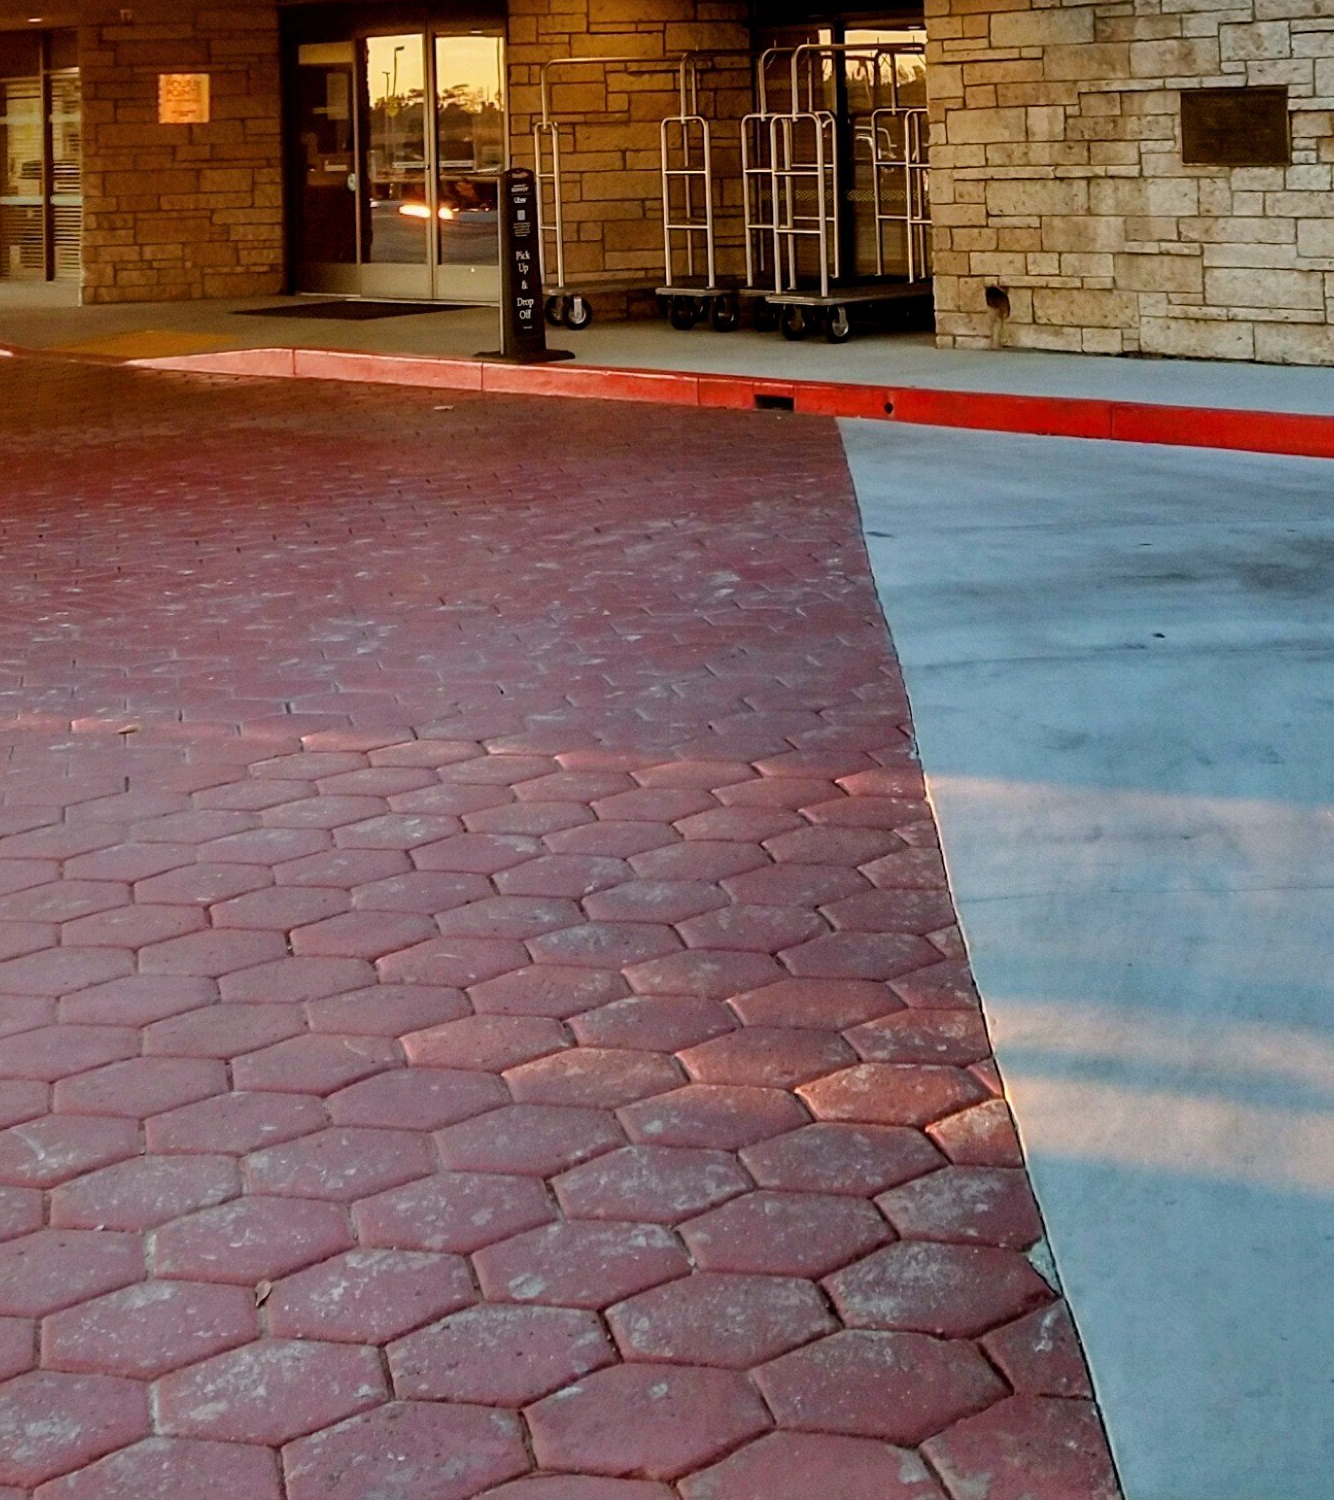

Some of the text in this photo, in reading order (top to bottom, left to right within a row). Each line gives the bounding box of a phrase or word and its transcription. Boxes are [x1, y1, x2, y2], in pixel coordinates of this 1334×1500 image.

[515, 249, 531, 261] Pick
[518, 262, 529, 274] Up
[521, 280, 528, 290] &
[516, 297, 534, 308] Drop
[519, 309, 532, 320] Off
